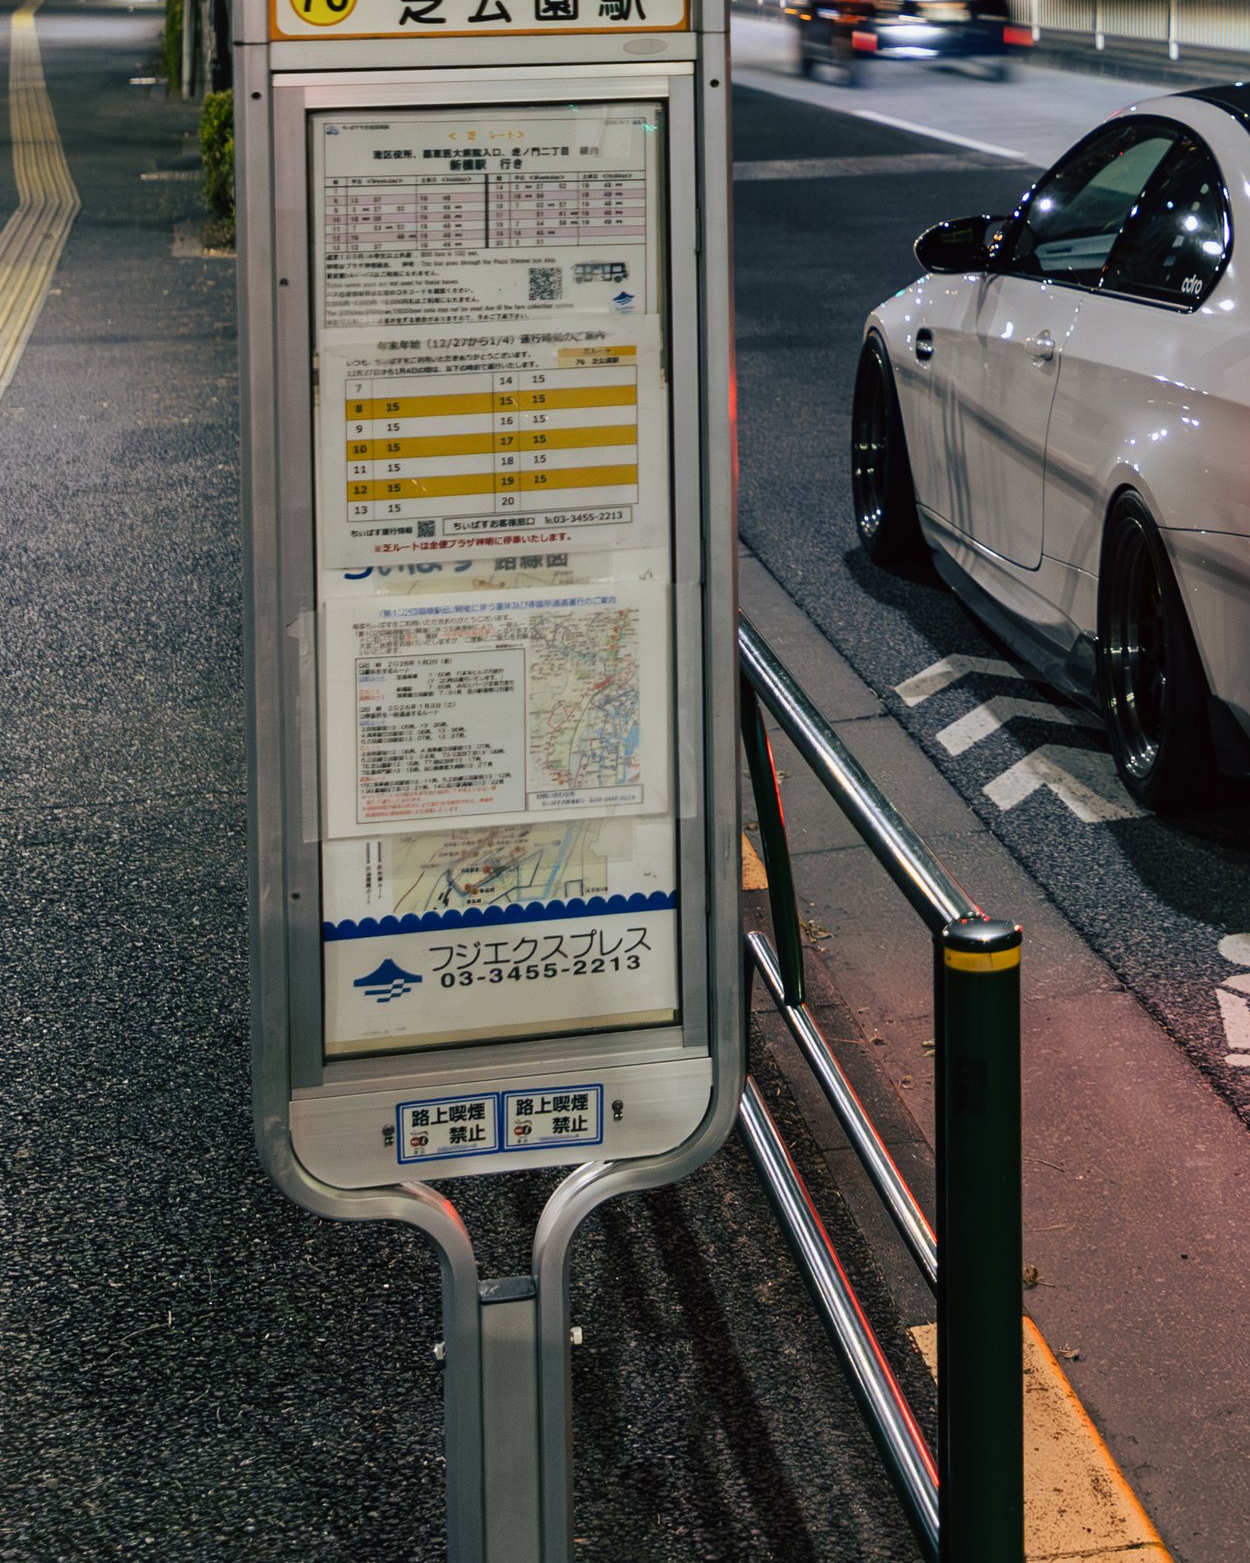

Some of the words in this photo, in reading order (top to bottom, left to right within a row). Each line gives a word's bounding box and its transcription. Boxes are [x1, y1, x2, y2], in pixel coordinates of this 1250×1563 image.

[500, 159, 522, 170] 行き
[500, 376, 512, 385] 14
[532, 375, 545, 383] 15
[500, 397, 513, 405] 15
[532, 395, 545, 403] 15
[387, 403, 400, 412] 15
[501, 416, 513, 425] 16
[533, 414, 545, 423] 15
[387, 423, 400, 432] 15
[501, 436, 513, 445] 17
[533, 434, 546, 443] 15
[354, 445, 367, 454] 10
[387, 443, 400, 452] 15
[501, 456, 514, 465] 18
[534, 454, 546, 463] 15
[354, 465, 366, 474] 11
[388, 463, 400, 472] 15
[501, 476, 514, 485] 19
[534, 475, 547, 483] 15
[354, 485, 367, 494] 12
[388, 484, 401, 492] 15
[502, 496, 515, 506] 20
[354, 505, 368, 514] 13
[388, 504, 401, 513] 15
[429, 927, 651, 972] フジエクスプレス
[440, 955, 641, 988] 03-3455-2213
[516, 1093, 588, 1117] 路上喫煙
[411, 1103, 486, 1128] 路上喫煙
[552, 1115, 588, 1134] 禁止
[449, 1124, 486, 1145] 禁止
